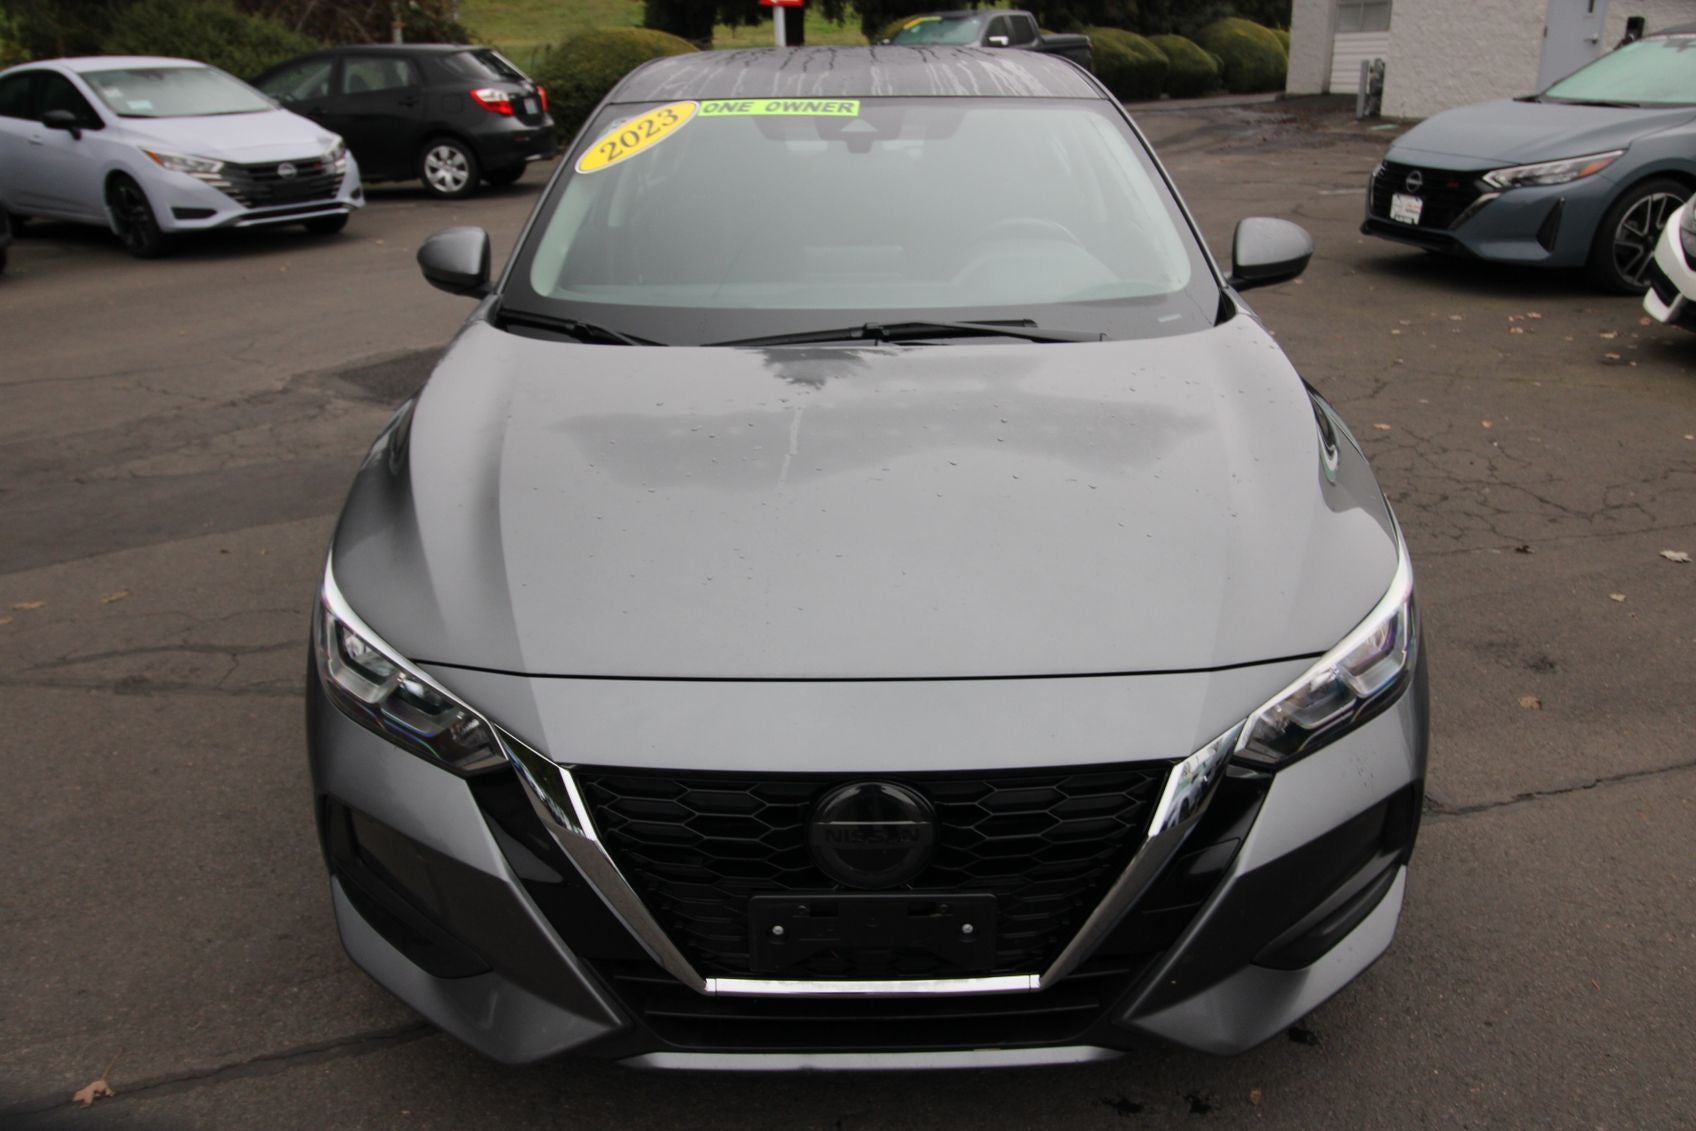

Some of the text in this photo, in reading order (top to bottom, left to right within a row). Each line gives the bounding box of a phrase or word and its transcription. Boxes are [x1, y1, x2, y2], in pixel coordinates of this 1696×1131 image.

[703, 101, 854, 114] ONE OWNER
[600, 108, 679, 162] 2023
